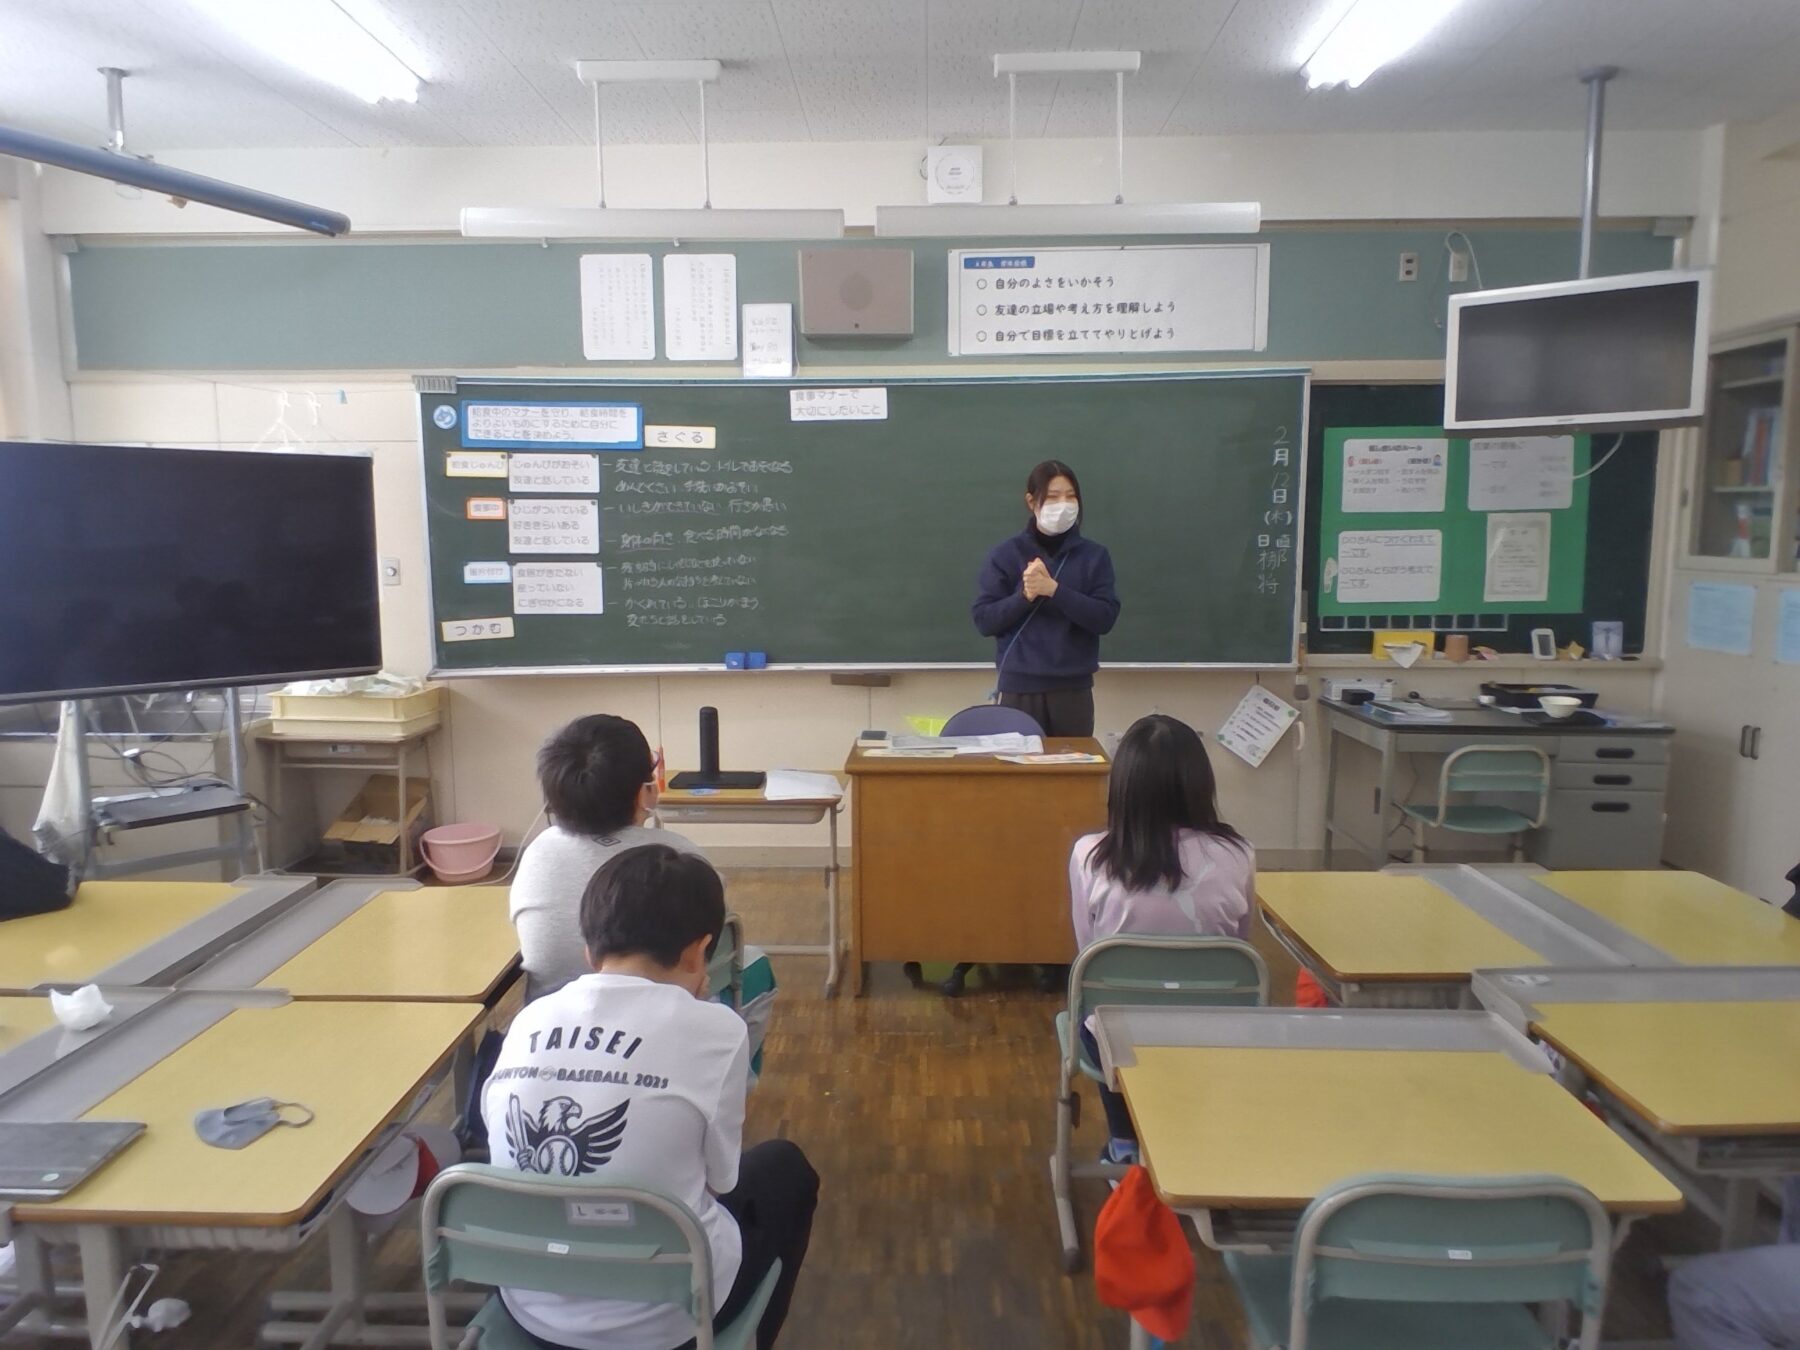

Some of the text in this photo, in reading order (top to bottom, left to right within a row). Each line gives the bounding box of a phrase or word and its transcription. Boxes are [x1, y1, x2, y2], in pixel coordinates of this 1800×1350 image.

[995, 277, 1115, 290] 自分のよさをいかそう
[994, 302, 1176, 317] 友達の立場や考え方を理解しよう
[994, 329, 1176, 343] 自分で目標を立ててやりとげよう
[795, 404, 881, 417] 大切にしたいこと
[455, 623, 502, 636] つかむ
[529, 1026, 643, 1060] TAISEI
[556, 1068, 630, 1085] BASEBALL
[634, 1073, 669, 1089] 2025
